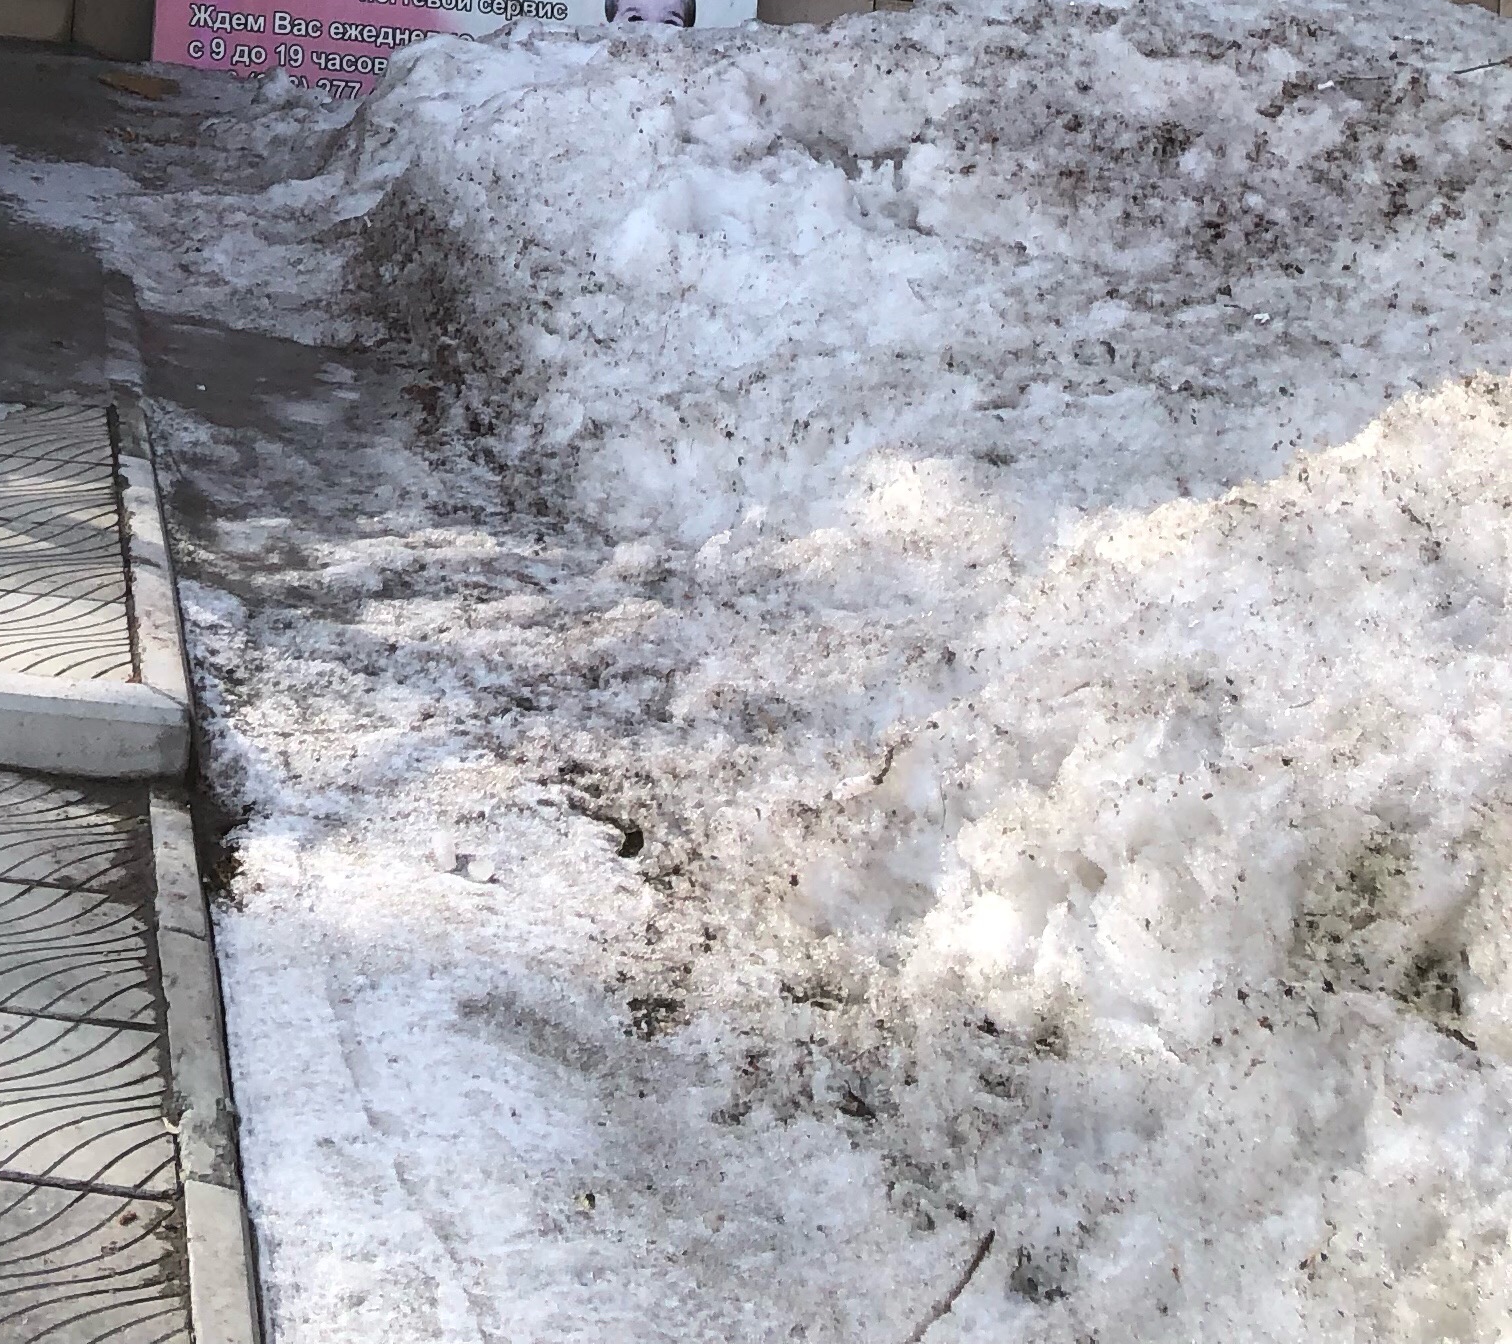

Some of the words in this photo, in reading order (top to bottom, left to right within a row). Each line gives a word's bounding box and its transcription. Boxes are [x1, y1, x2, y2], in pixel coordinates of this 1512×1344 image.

[189, 4, 266, 32] Ждем
[273, 12, 323, 37] Вас
[188, 40, 204, 58] с
[210, 38, 226, 60] 9
[232, 44, 267, 67] до
[274, 43, 304, 67] 19
[311, 50, 388, 75] часов
